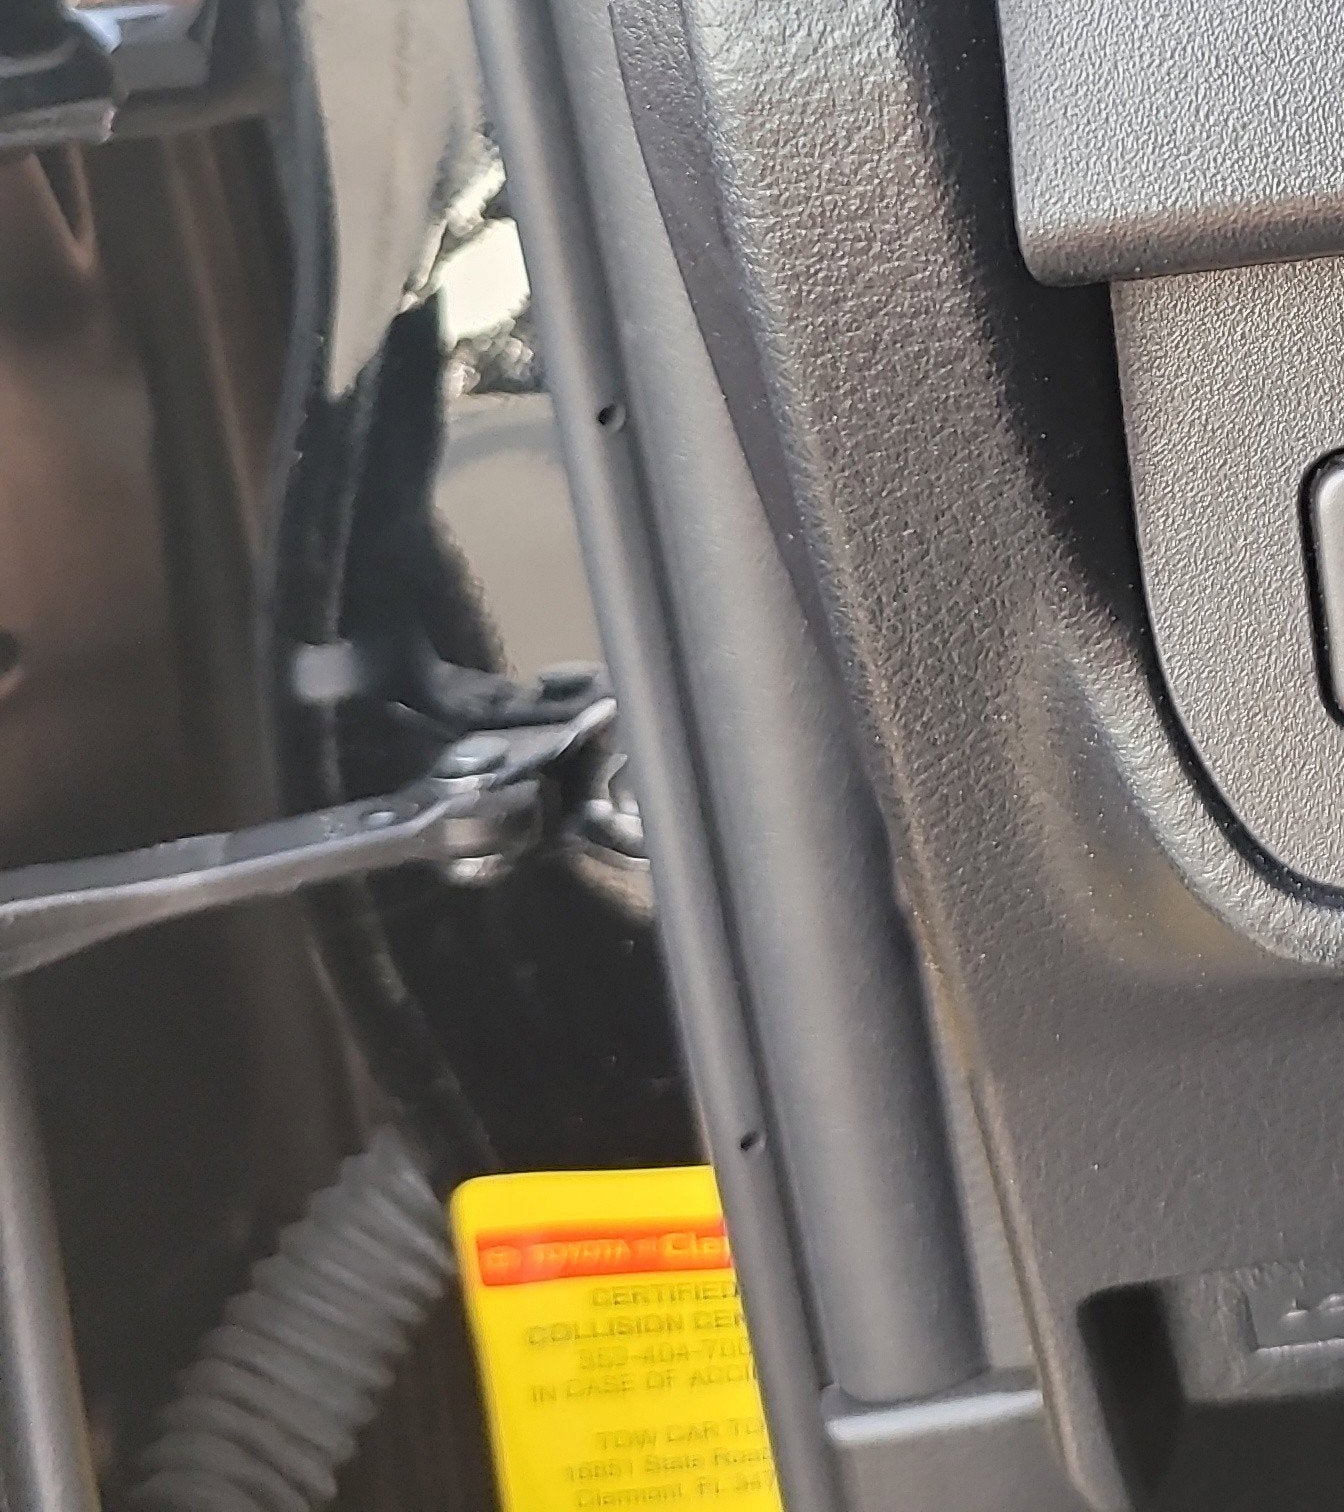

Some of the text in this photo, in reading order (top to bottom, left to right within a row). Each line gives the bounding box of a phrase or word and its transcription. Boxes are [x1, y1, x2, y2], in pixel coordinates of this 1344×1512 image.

[526, 1311, 684, 1346] COLLISION
[530, 1384, 558, 1404] IN
[564, 1369, 635, 1399] CASE
[646, 1367, 674, 1390] OF
